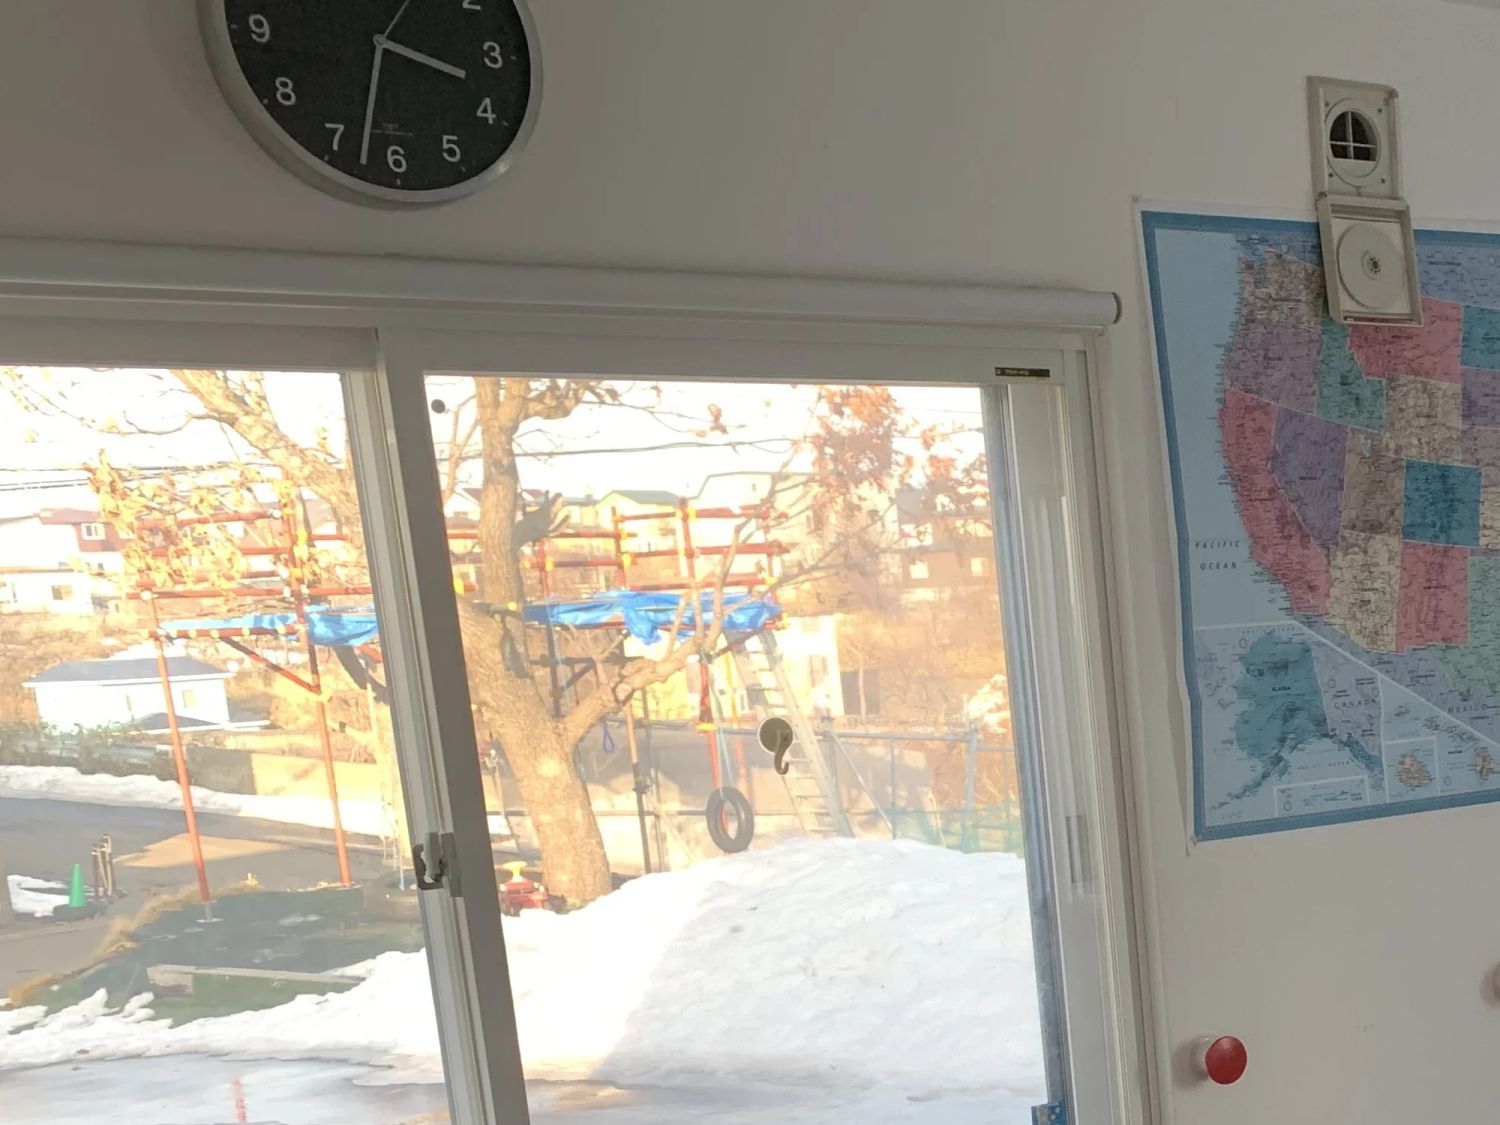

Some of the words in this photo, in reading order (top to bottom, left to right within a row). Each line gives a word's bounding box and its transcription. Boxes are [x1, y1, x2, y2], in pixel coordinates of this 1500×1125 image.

[249, 14, 270, 42] 9
[483, 42, 502, 68] 3
[276, 77, 296, 105] 8
[477, 97, 496, 124] 4
[325, 123, 344, 151] 7
[443, 135, 460, 162] 5
[387, 146, 406, 172] 6
[1199, 561, 1237, 571] OCEAN
